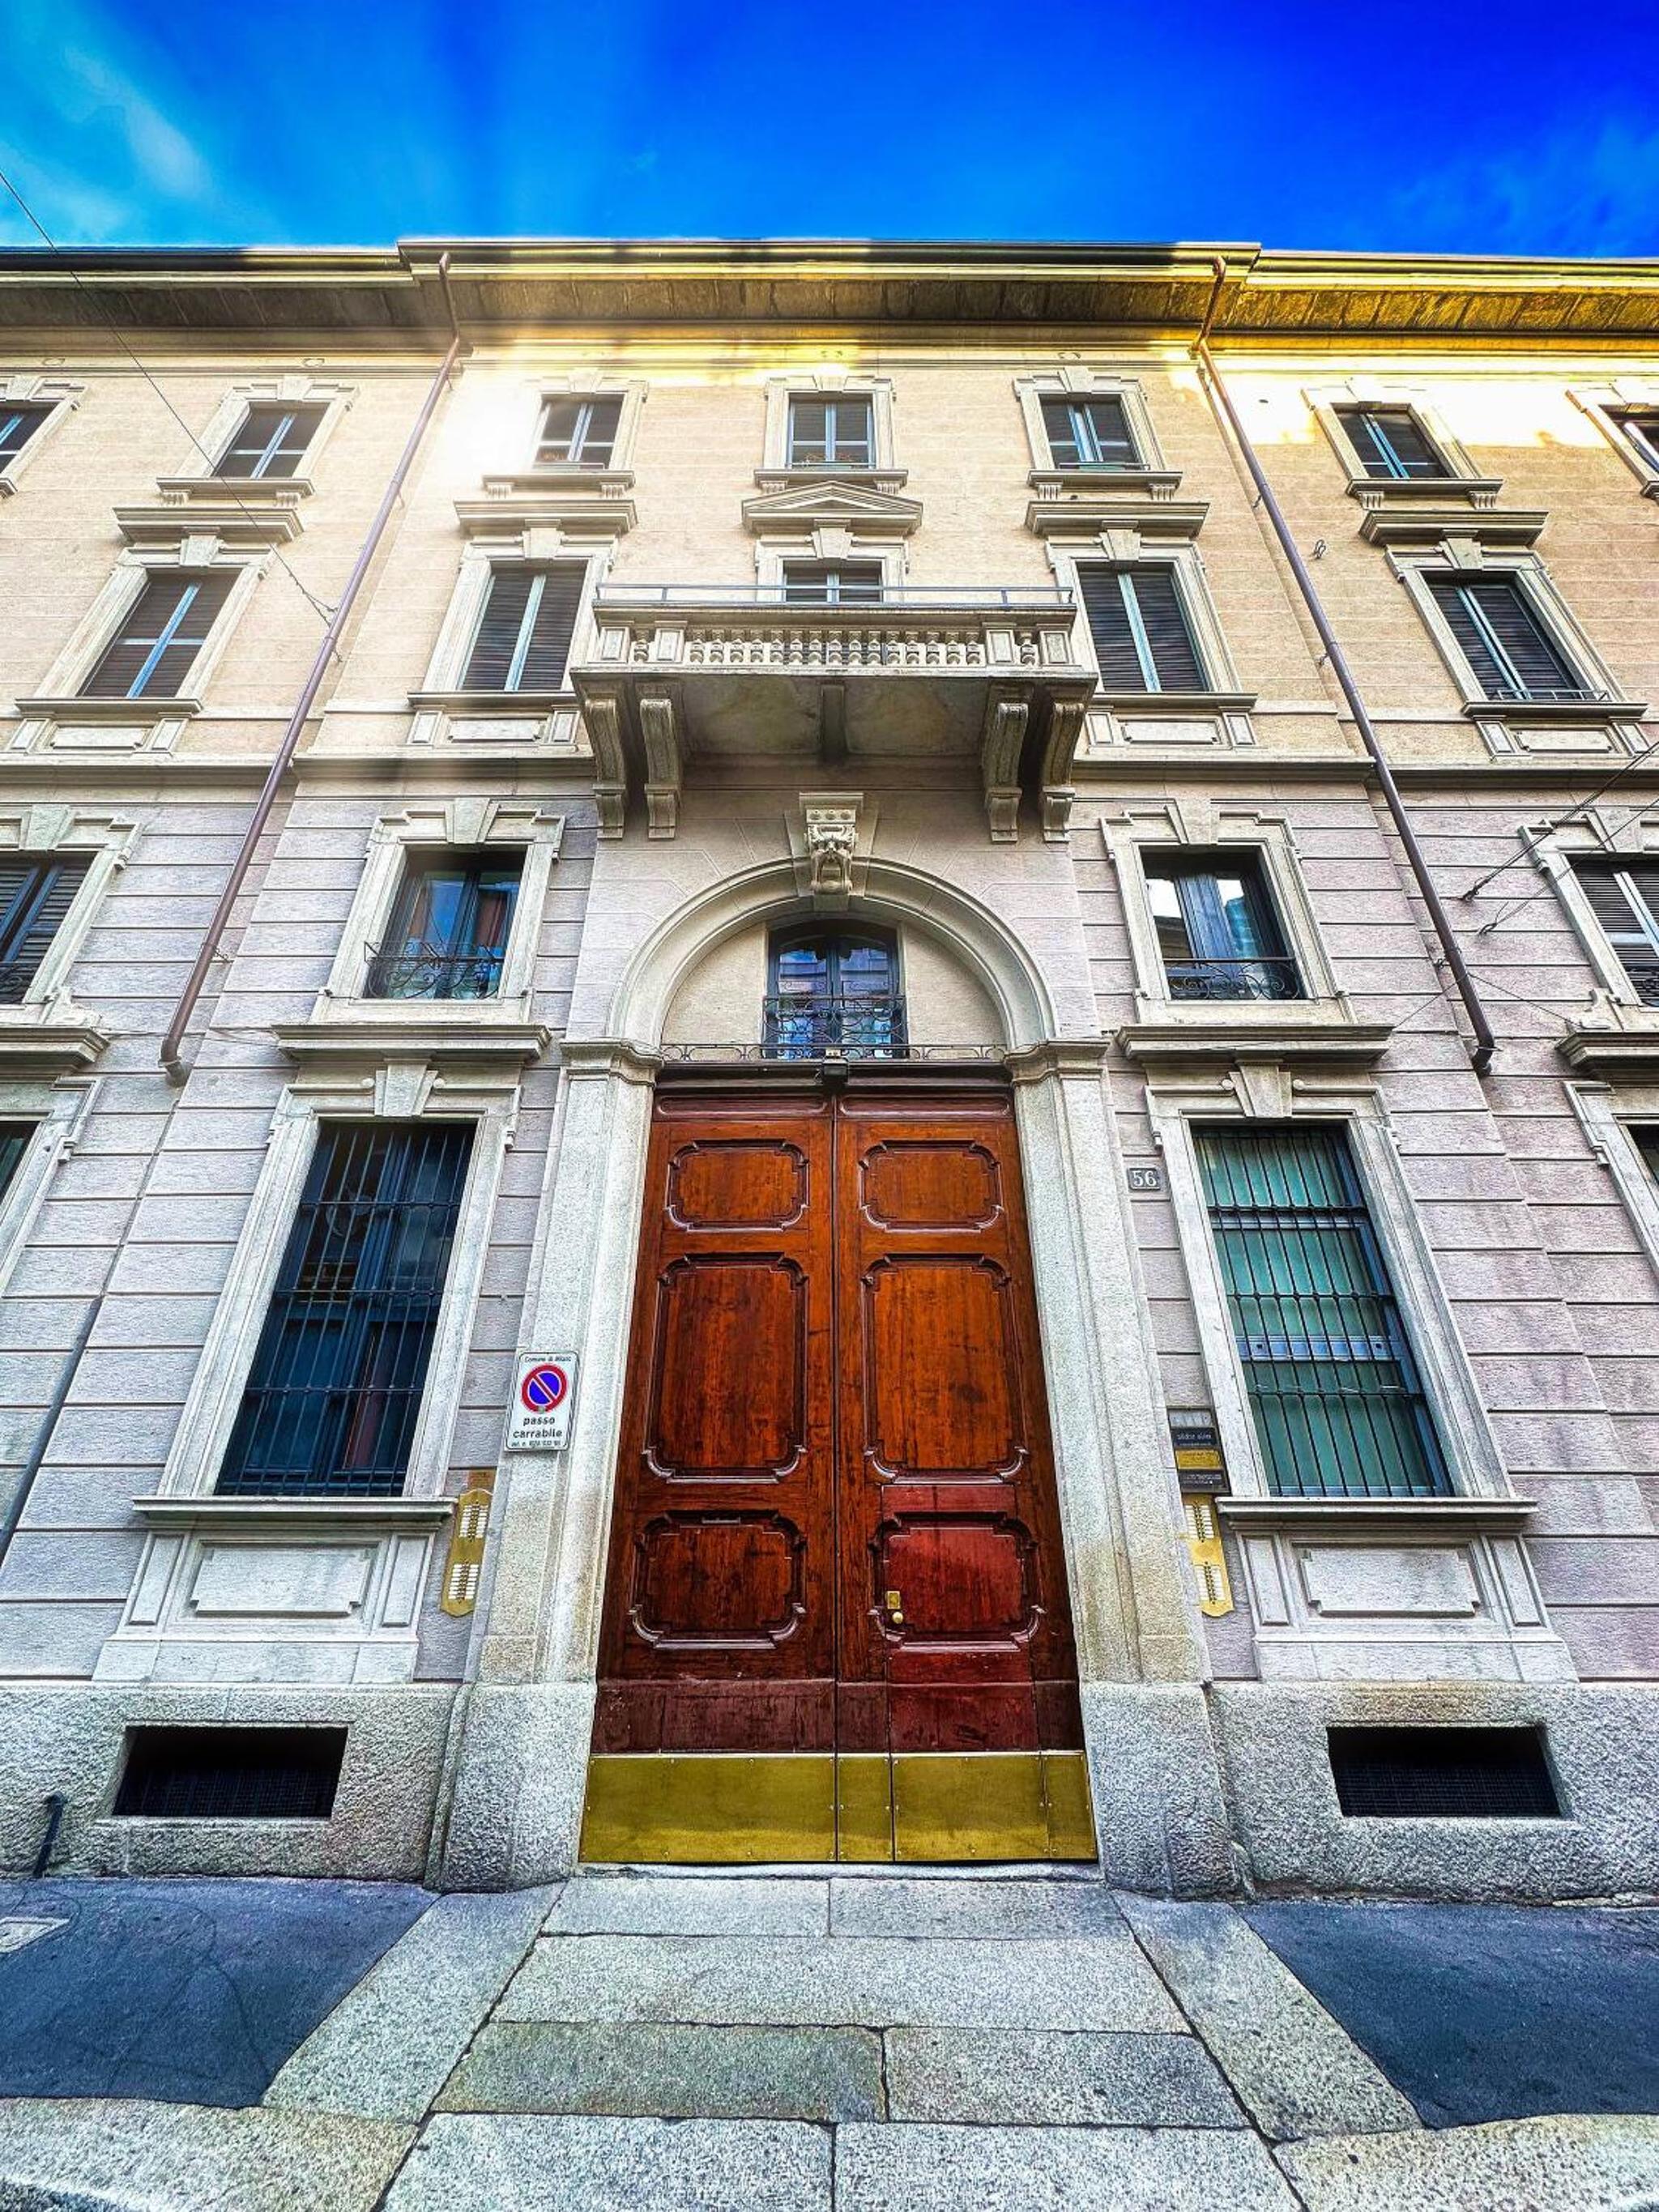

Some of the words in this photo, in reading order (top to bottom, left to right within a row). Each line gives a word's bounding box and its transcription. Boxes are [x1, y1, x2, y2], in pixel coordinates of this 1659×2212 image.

[1132, 1170, 1157, 1187] 56
[522, 1417, 556, 1426] passo
[513, 1428, 562, 1438] carrabile
